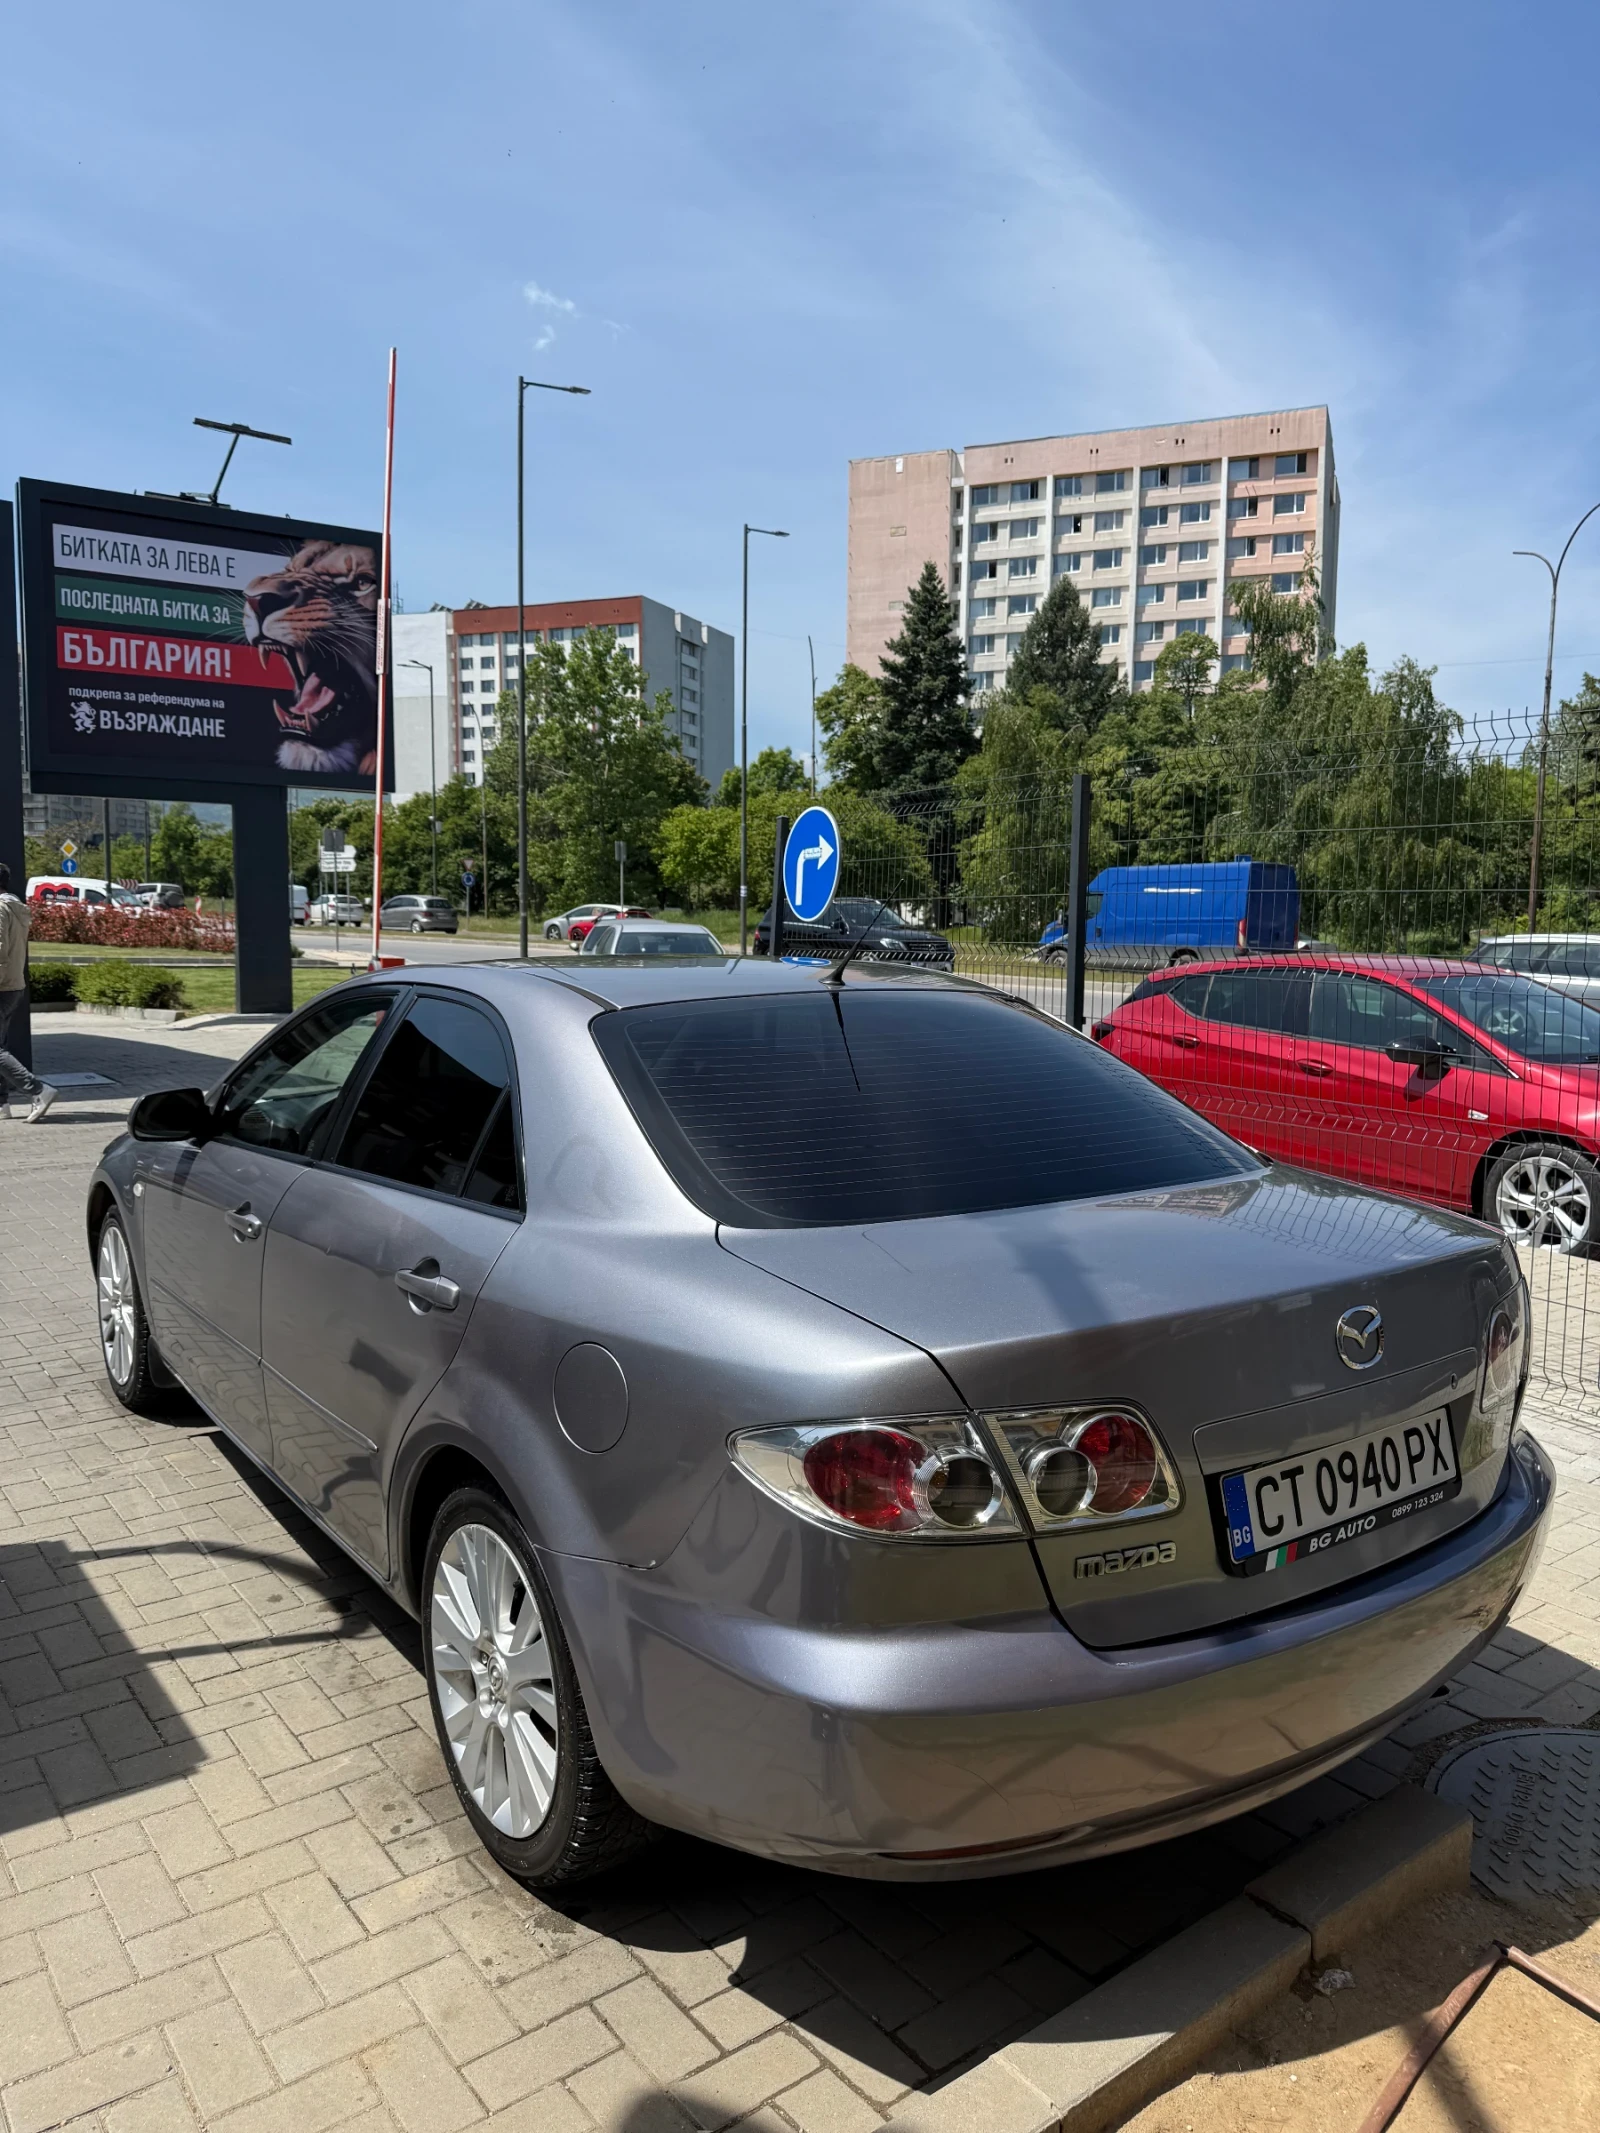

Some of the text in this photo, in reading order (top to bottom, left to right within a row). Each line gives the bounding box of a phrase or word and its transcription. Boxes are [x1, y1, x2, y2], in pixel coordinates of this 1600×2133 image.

[60, 533, 236, 578] БИТКАТА ЗА ЛЕВА Е
[60, 587, 231, 625] ПОСЛЕДНАТА БИТКА ЗА
[63, 632, 231, 678] БЪЛГАРИЯ!
[68, 686, 225, 709] подкрепа за референдума на
[99, 709, 226, 738] ВЪЗРАЖДАНЕ
[1316, 1436, 1401, 1516] 0940
[1232, 1524, 1251, 1548] BG
[1308, 1490, 1444, 1553] BG AUTO 0899 123 324
